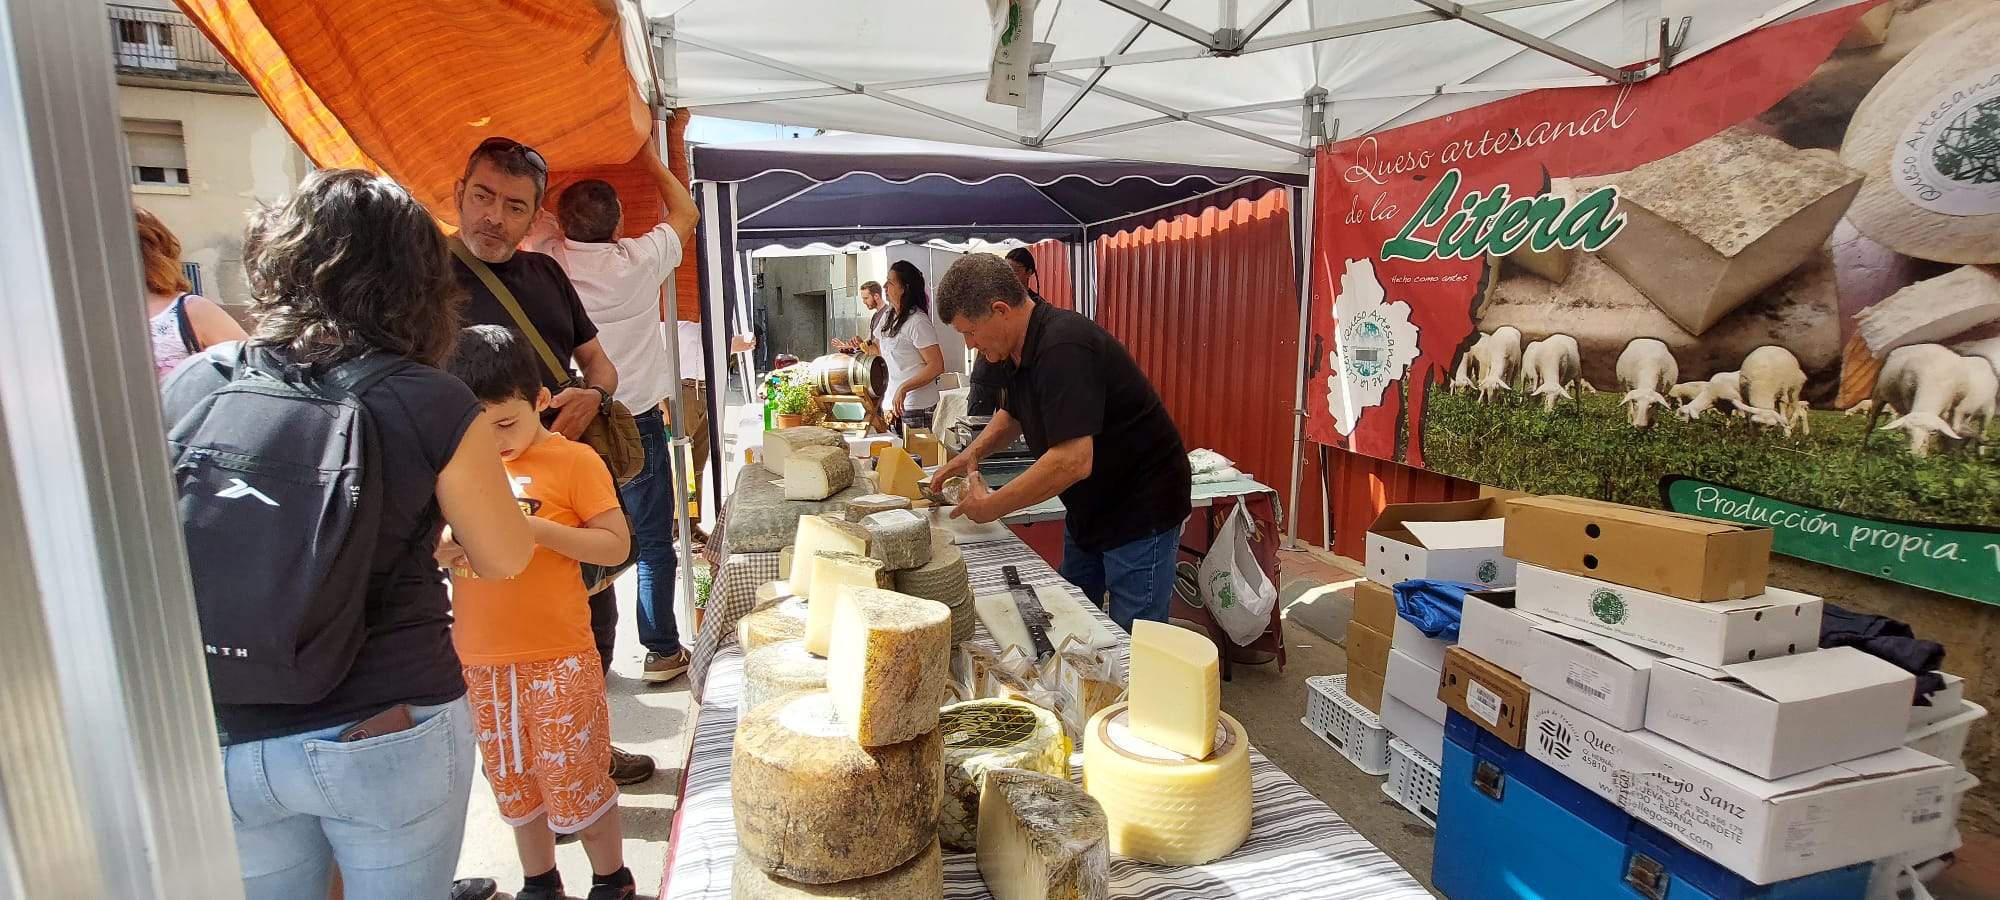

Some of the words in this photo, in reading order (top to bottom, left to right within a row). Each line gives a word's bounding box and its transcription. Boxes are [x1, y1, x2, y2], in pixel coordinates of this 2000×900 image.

[1344, 137, 1435, 185] Queso
[1441, 85, 1637, 165] artesanal
[1906, 74, 2000, 150] Artesana
[1346, 194, 1365, 225] de
[1370, 192, 1399, 221] la
[1380, 168, 1628, 262] Litera
[1693, 486, 1840, 538] Producción
[1849, 525, 1968, 563] propia.
[1582, 756, 1607, 772] 45810
[1669, 799, 1681, 811] DE
[1700, 786, 1746, 819] Sanz
